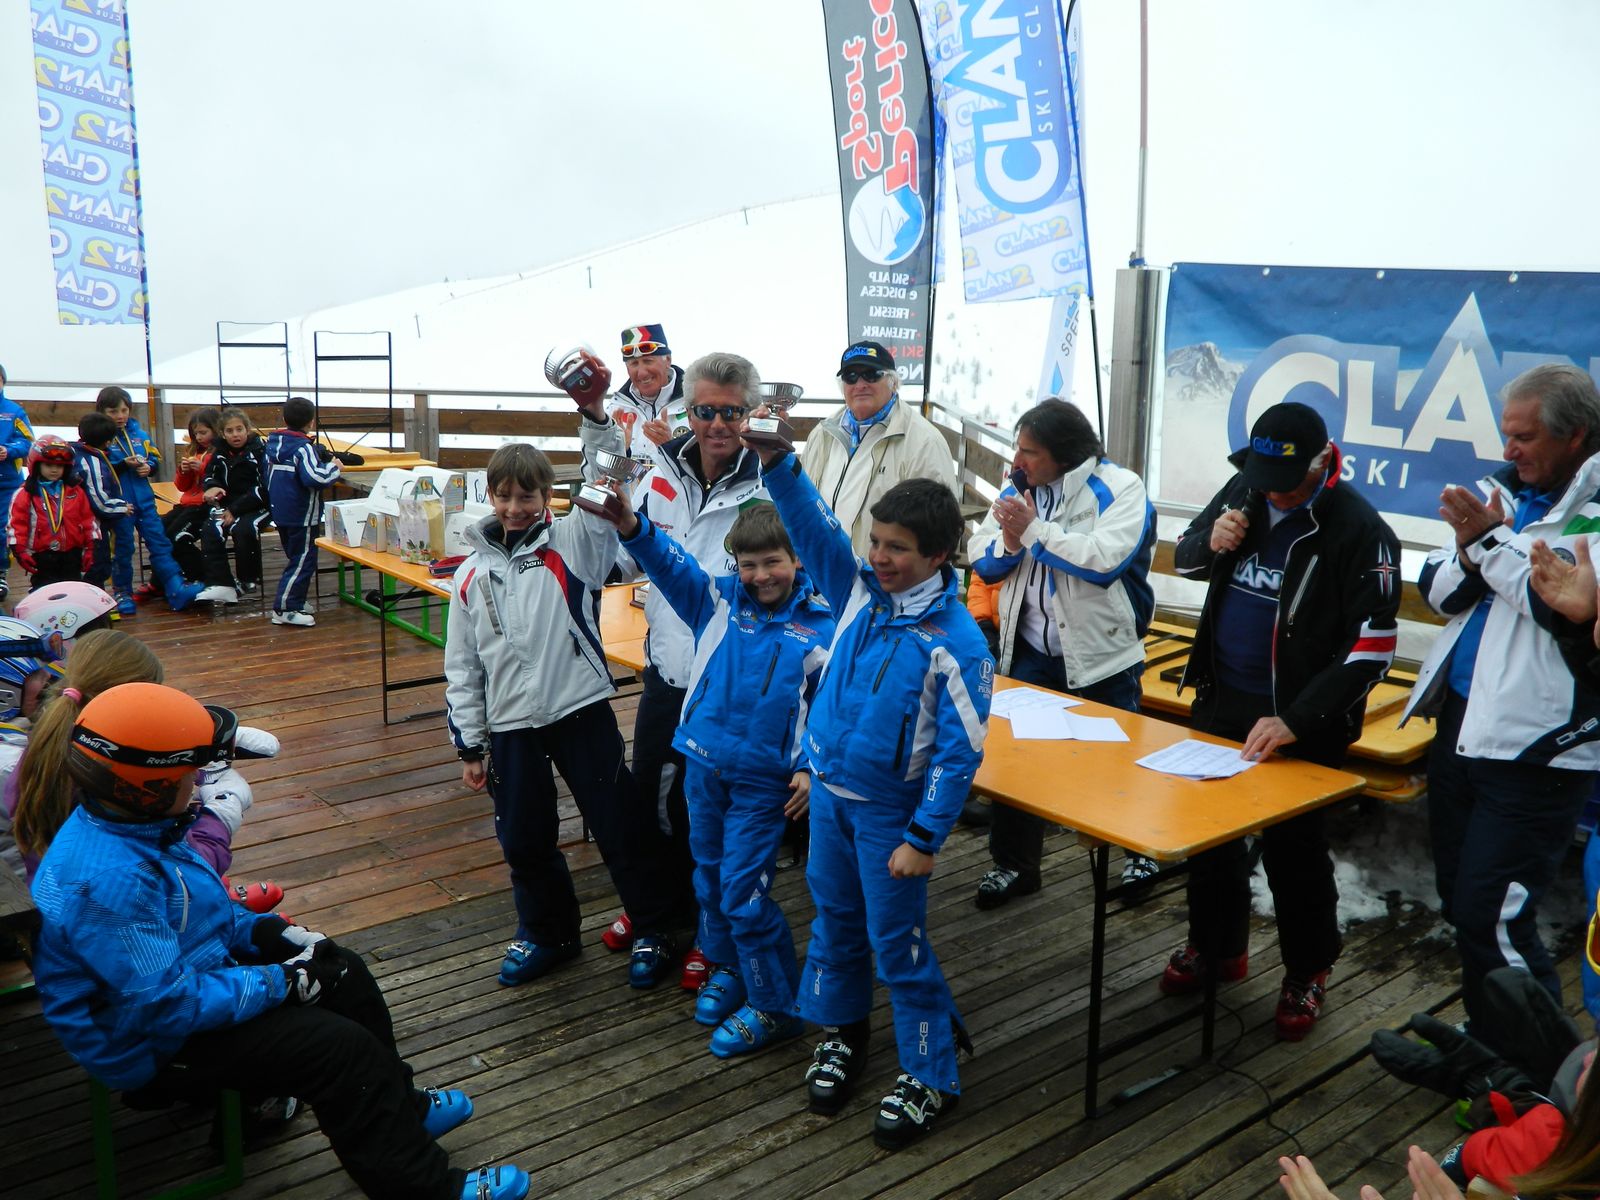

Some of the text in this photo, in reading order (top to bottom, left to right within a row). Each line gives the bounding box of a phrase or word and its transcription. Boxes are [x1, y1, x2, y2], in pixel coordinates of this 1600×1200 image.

[1033, 89, 1054, 133] SKI
[1340, 455, 1409, 489] SKI
[79, 733, 102, 750] Rebell
